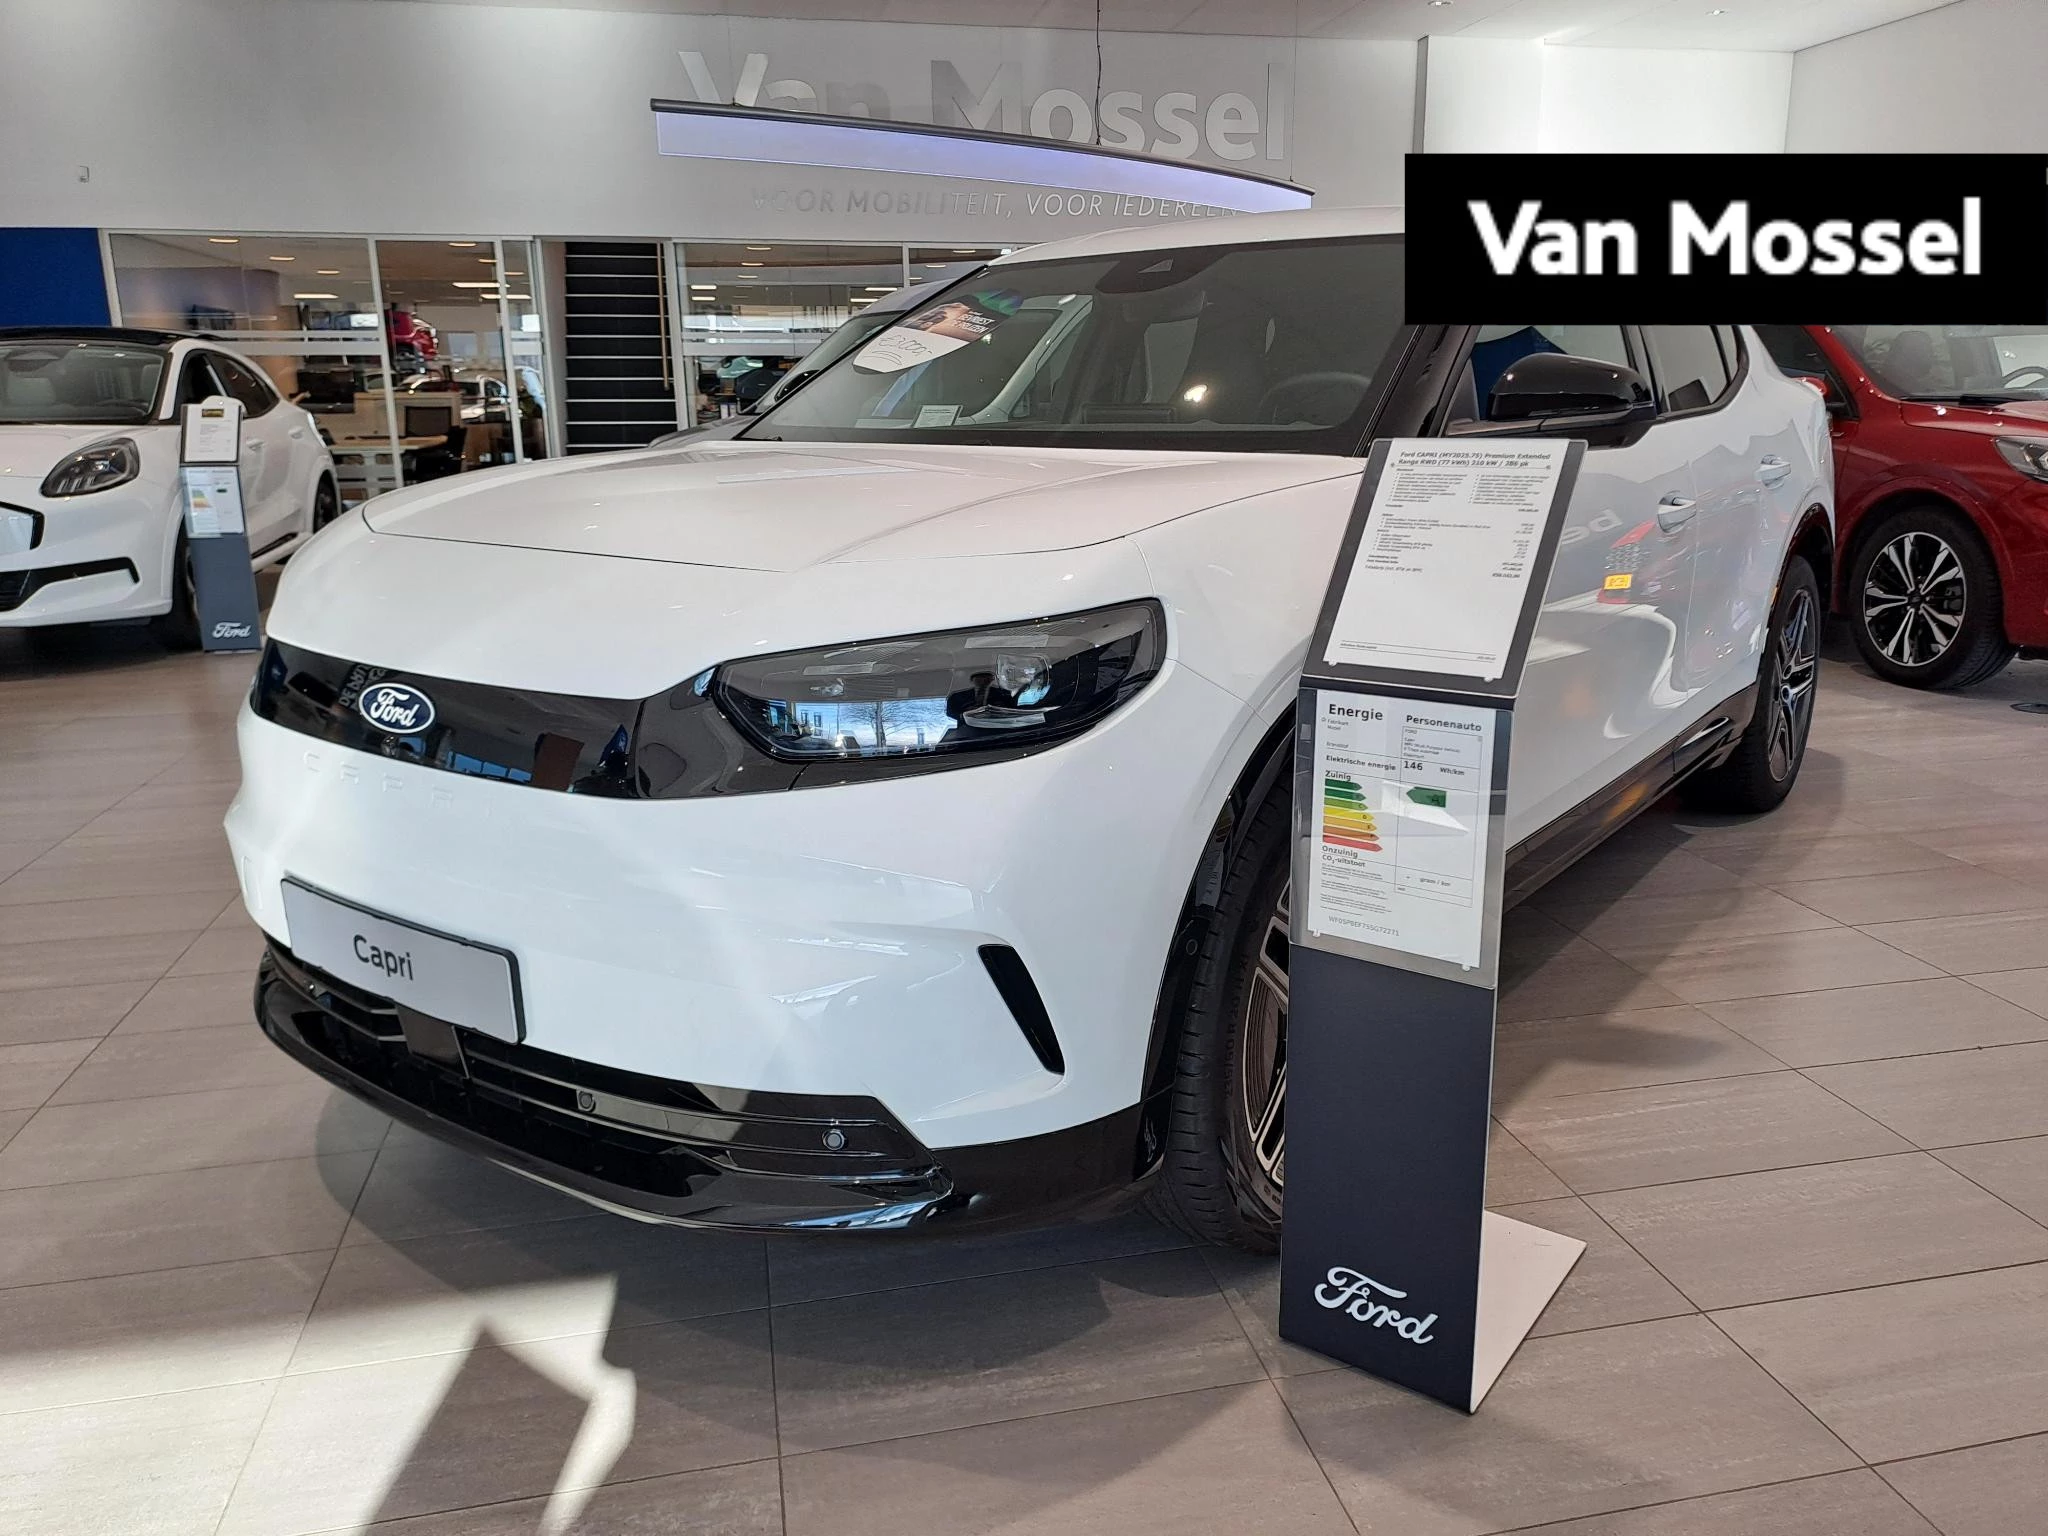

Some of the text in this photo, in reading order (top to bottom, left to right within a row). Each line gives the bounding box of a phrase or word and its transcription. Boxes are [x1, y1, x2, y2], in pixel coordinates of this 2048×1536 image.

[931, 59, 1285, 160] Mossel
[751, 187, 835, 212] VOOR
[846, 189, 1012, 219] MOBILITEIT,
[1026, 193, 1103, 217] VOOR
[212, 622, 251, 639] Ford
[369, 687, 421, 727] Ford
[1328, 703, 1383, 721] Energie
[1406, 714, 1482, 732] Personenauto
[1326, 755, 1396, 771] Elektrische energie
[1403, 760, 1465, 776] 146 Wh/km
[1325, 770, 1351, 781] Zuinig
[1322, 845, 1358, 859] Onzuinig
[353, 934, 413, 980] Capri
[1314, 1266, 1438, 1344] Ford
